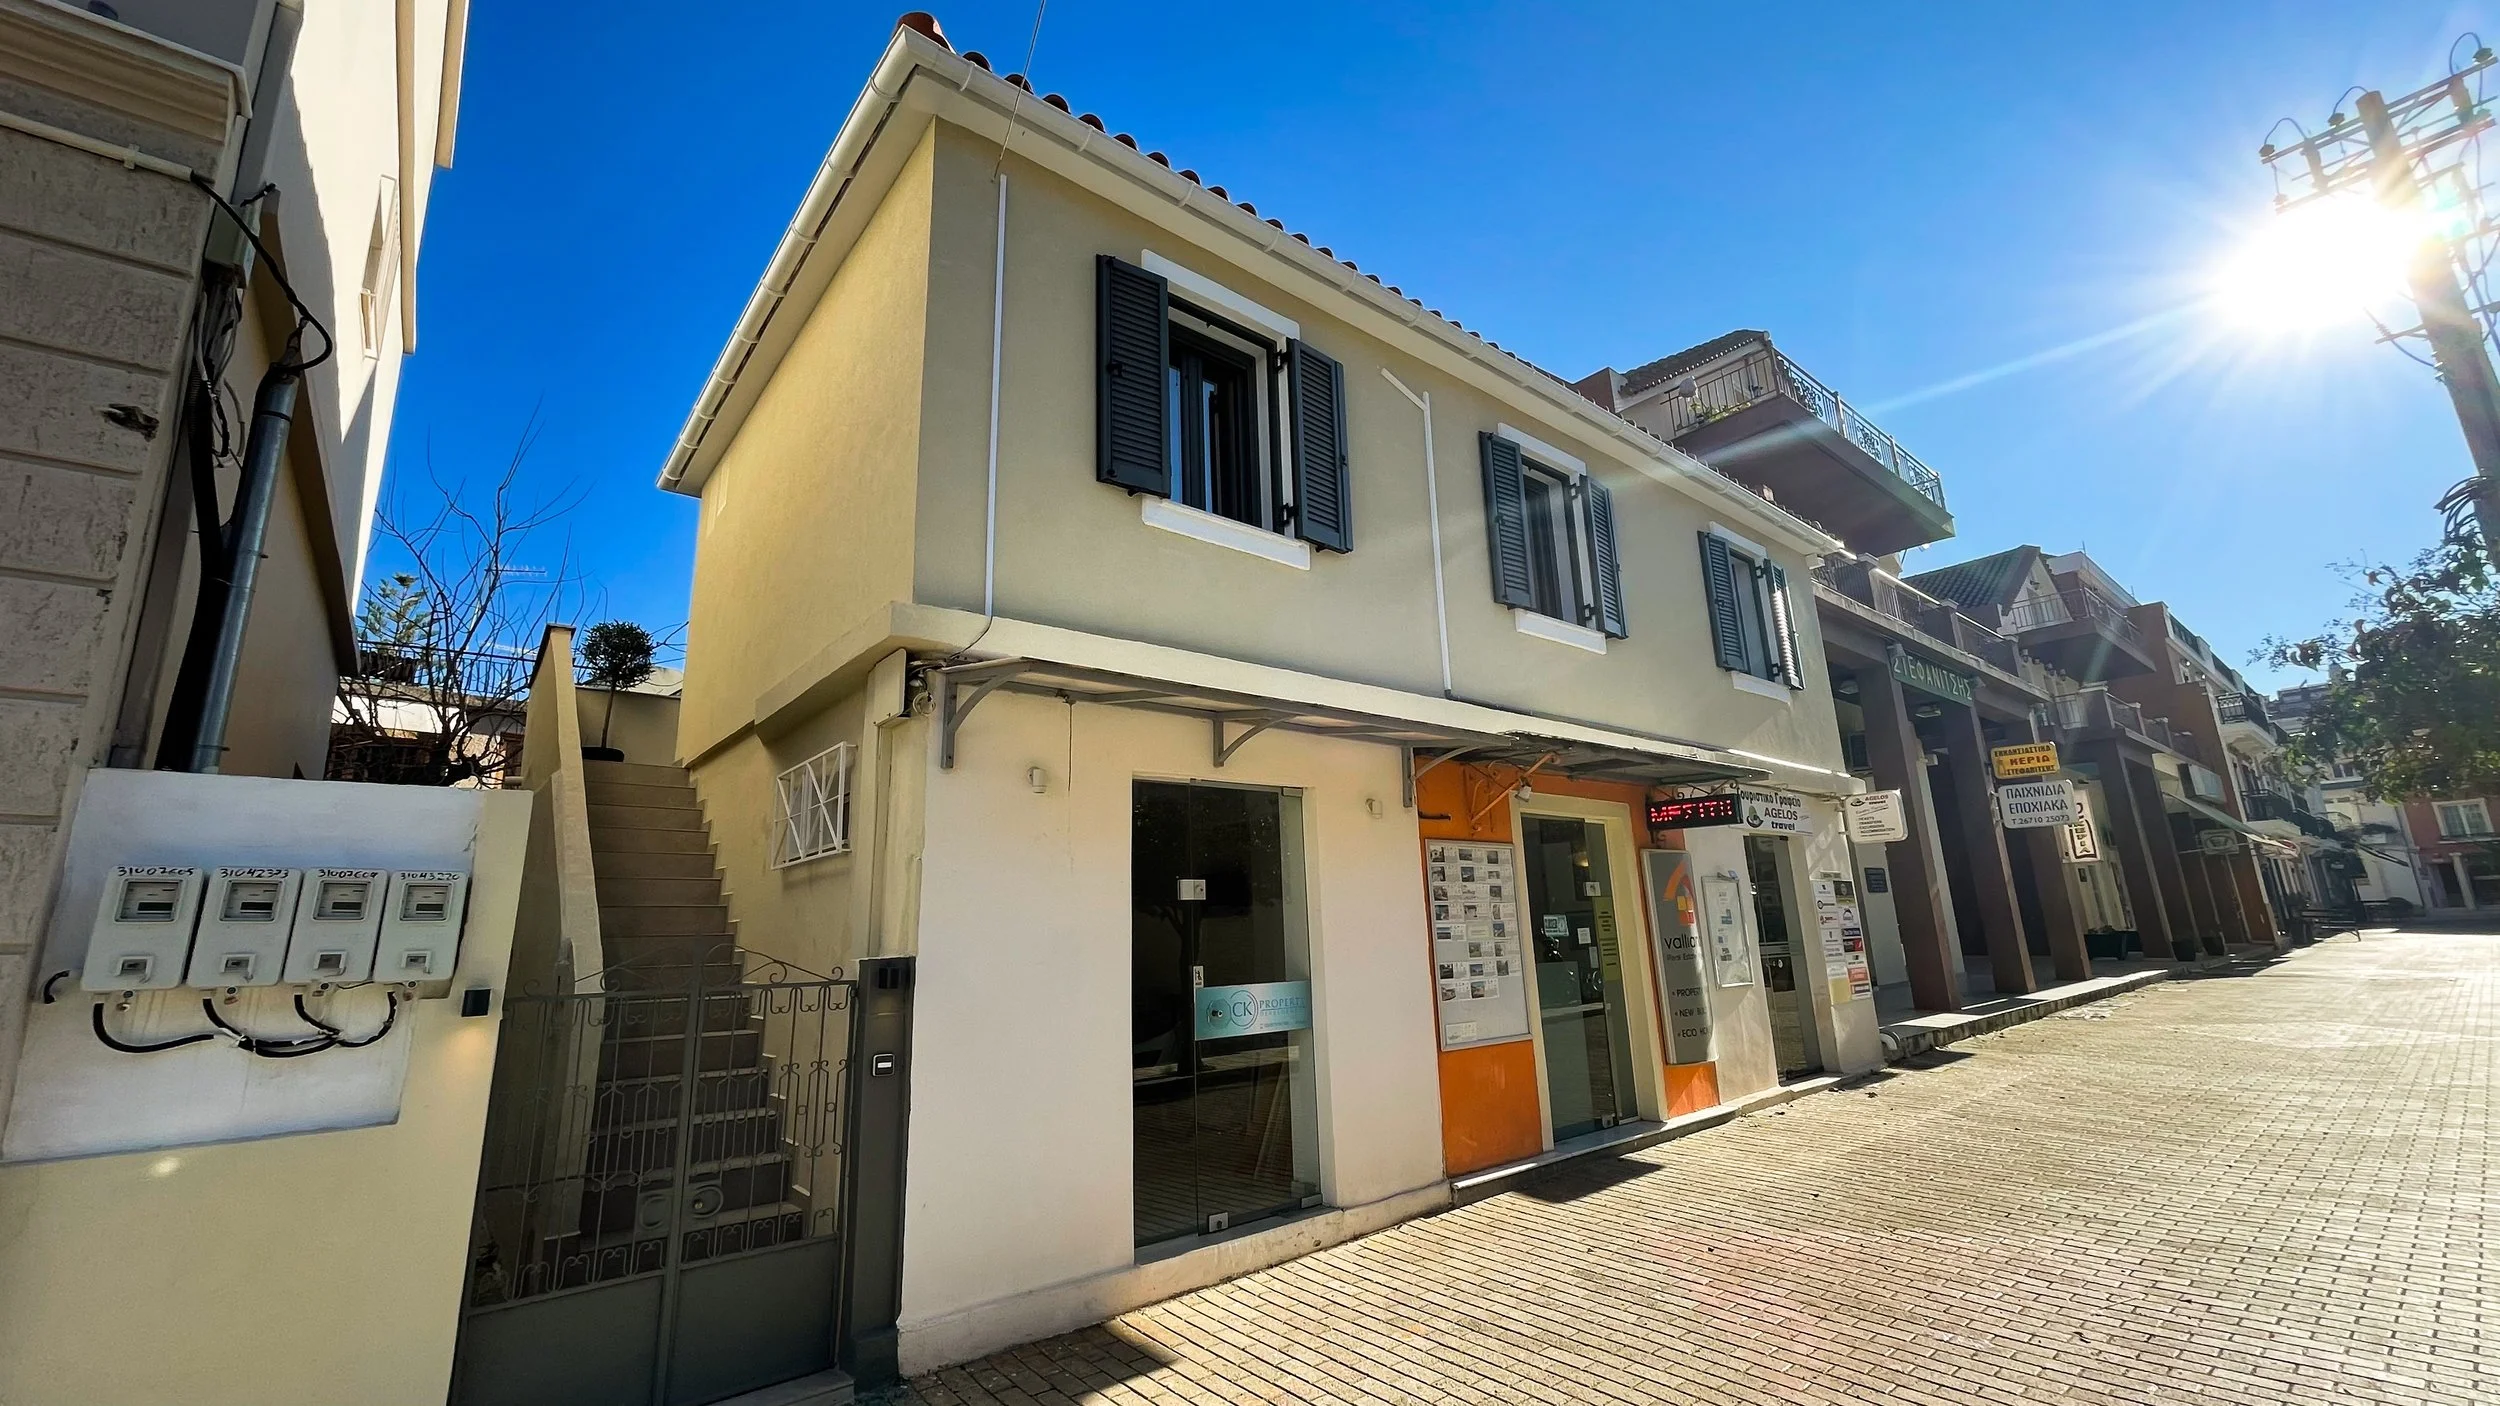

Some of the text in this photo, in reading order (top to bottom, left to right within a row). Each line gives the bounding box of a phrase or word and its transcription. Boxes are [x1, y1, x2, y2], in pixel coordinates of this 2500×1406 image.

[1893, 655, 1973, 701] ΣΤΕΦΑΝΙΤΣΗΣ
[2009, 754, 2051, 766] ΚΕΡΙΑ
[2006, 783, 2066, 800] ΠΑΙΧΝΙΔΙΑ
[1764, 807, 1798, 820] AGELOS
[2008, 799, 2069, 815] ΕΠΟΧΙΑΚΑ
[2045, 814, 2070, 823] 25073
[1771, 821, 1795, 830] travel
[1232, 1001, 1253, 1018] CK
[1681, 1028, 1697, 1038] ECO
